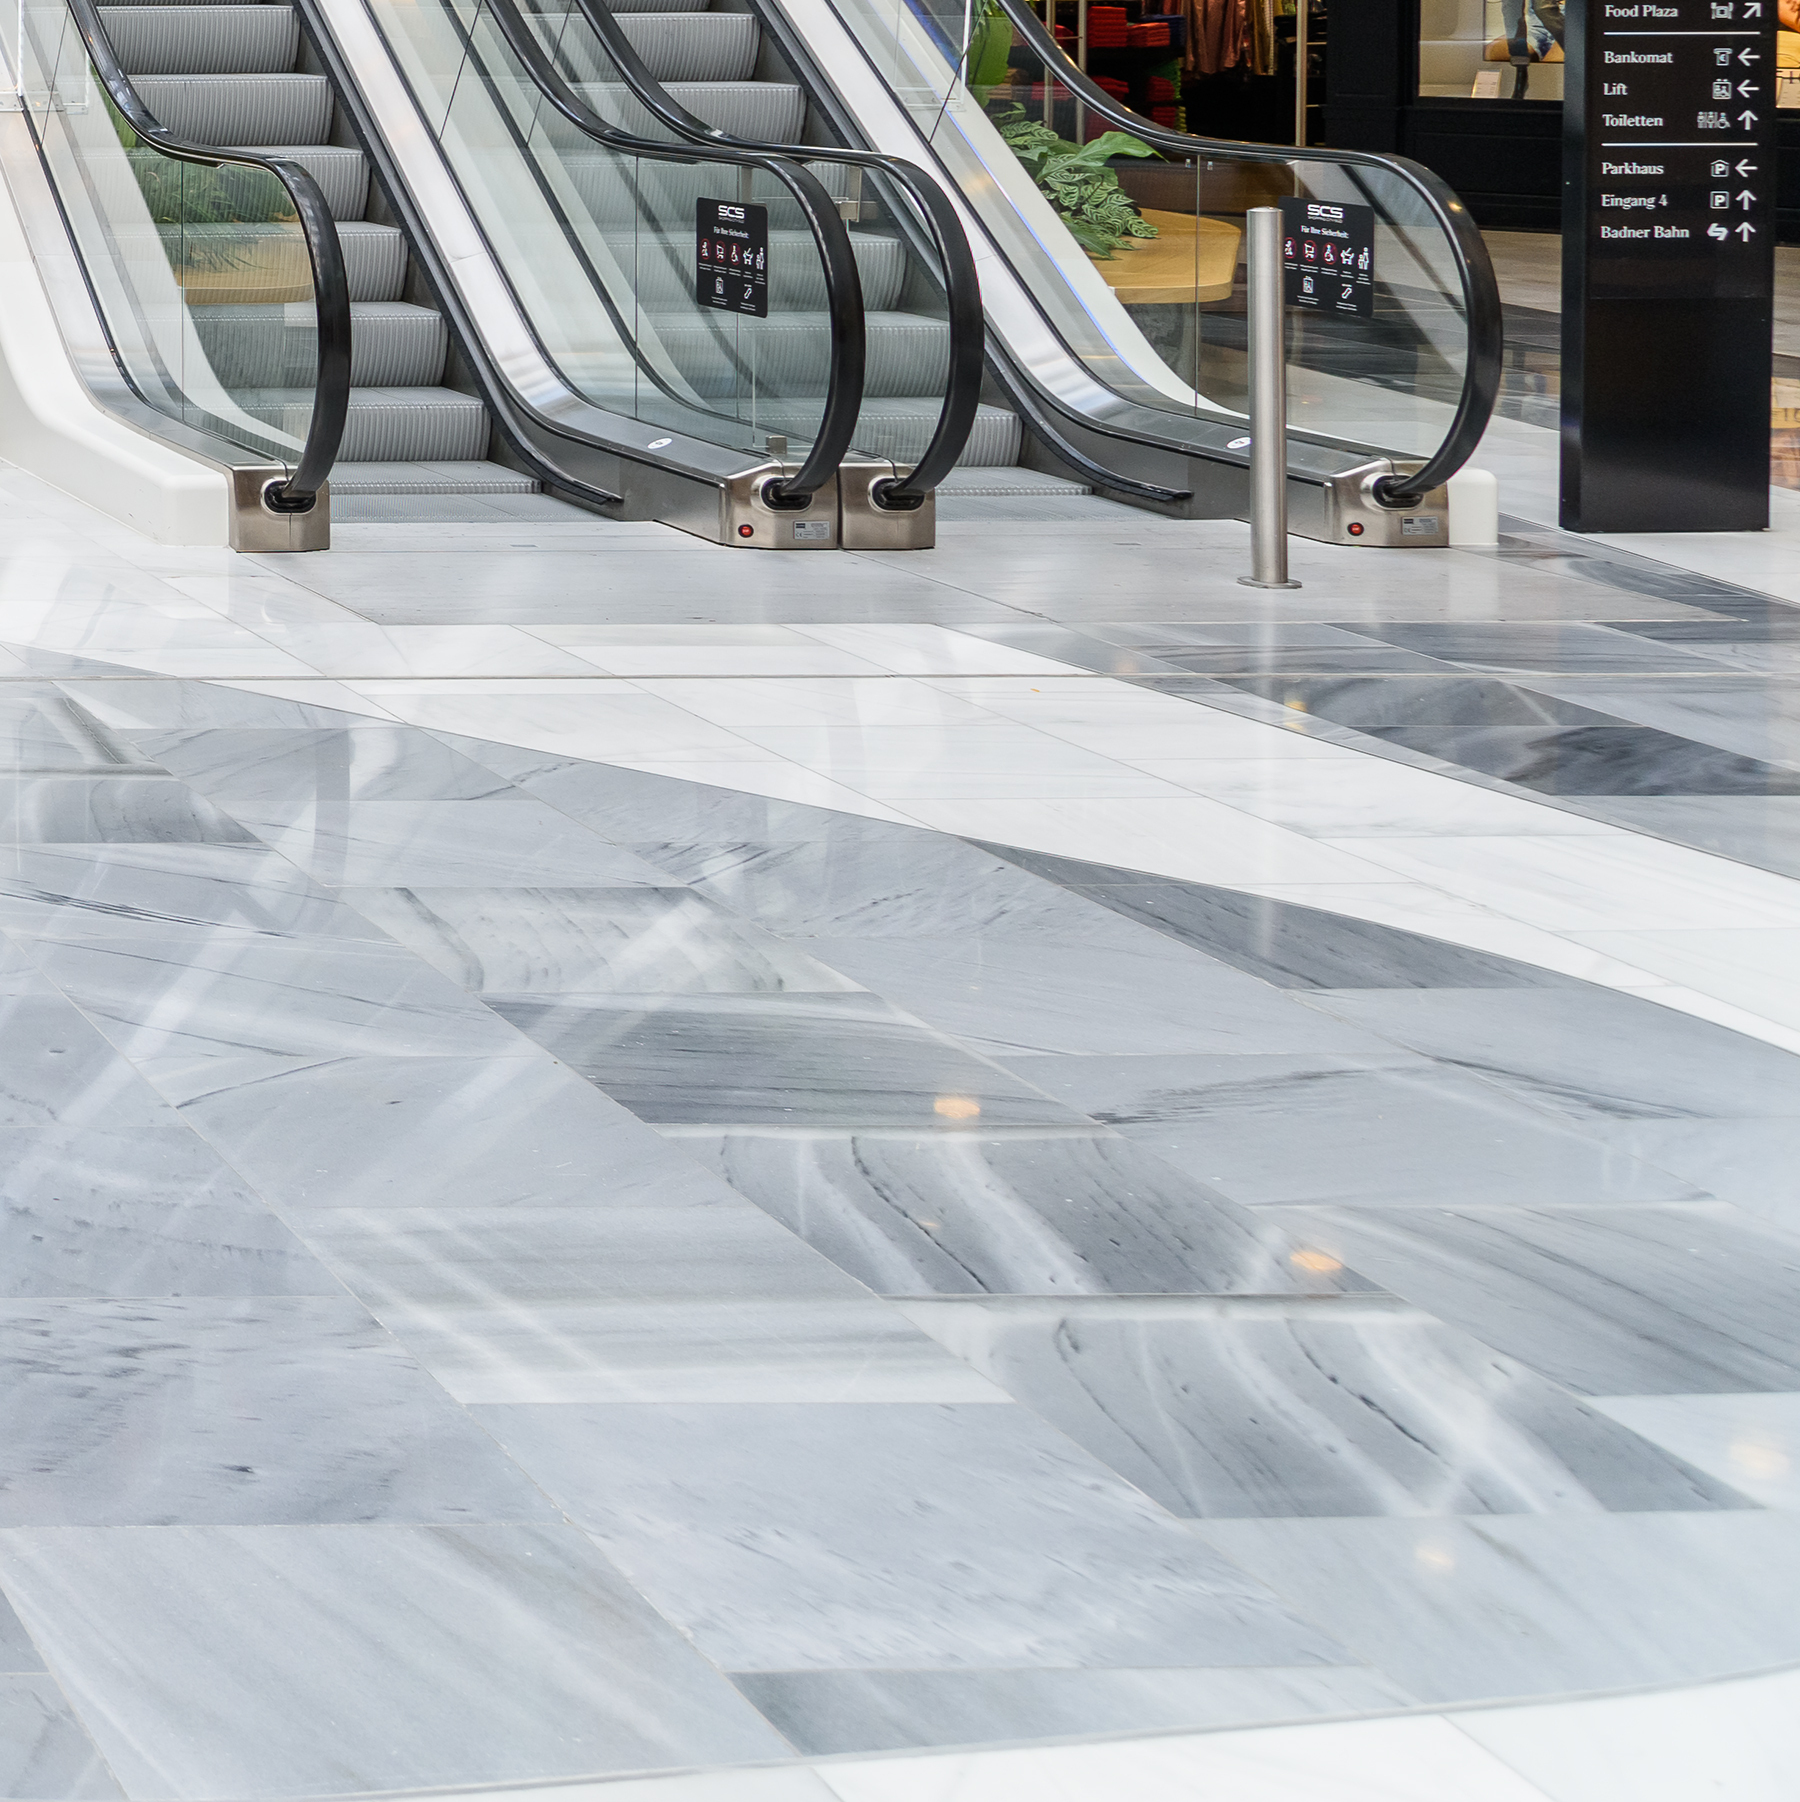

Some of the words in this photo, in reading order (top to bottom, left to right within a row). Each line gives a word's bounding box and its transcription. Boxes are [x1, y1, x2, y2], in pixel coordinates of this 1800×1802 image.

[1605, 4, 1639, 17] Food
[1642, 4, 1679, 18] Plaza
[1604, 50, 1674, 64] Bankomat
[1603, 82, 1629, 96] Lift
[1602, 113, 1664, 127] Toiletten
[1602, 161, 1665, 175] Parkhaus
[1601, 193, 1656, 210] Eingang
[1658, 194, 1668, 206] 4
[718, 204, 745, 219] SCS
[1307, 203, 1344, 219] SCS
[1600, 225, 1651, 239] Badner
[1653, 225, 1690, 239] Bahn
